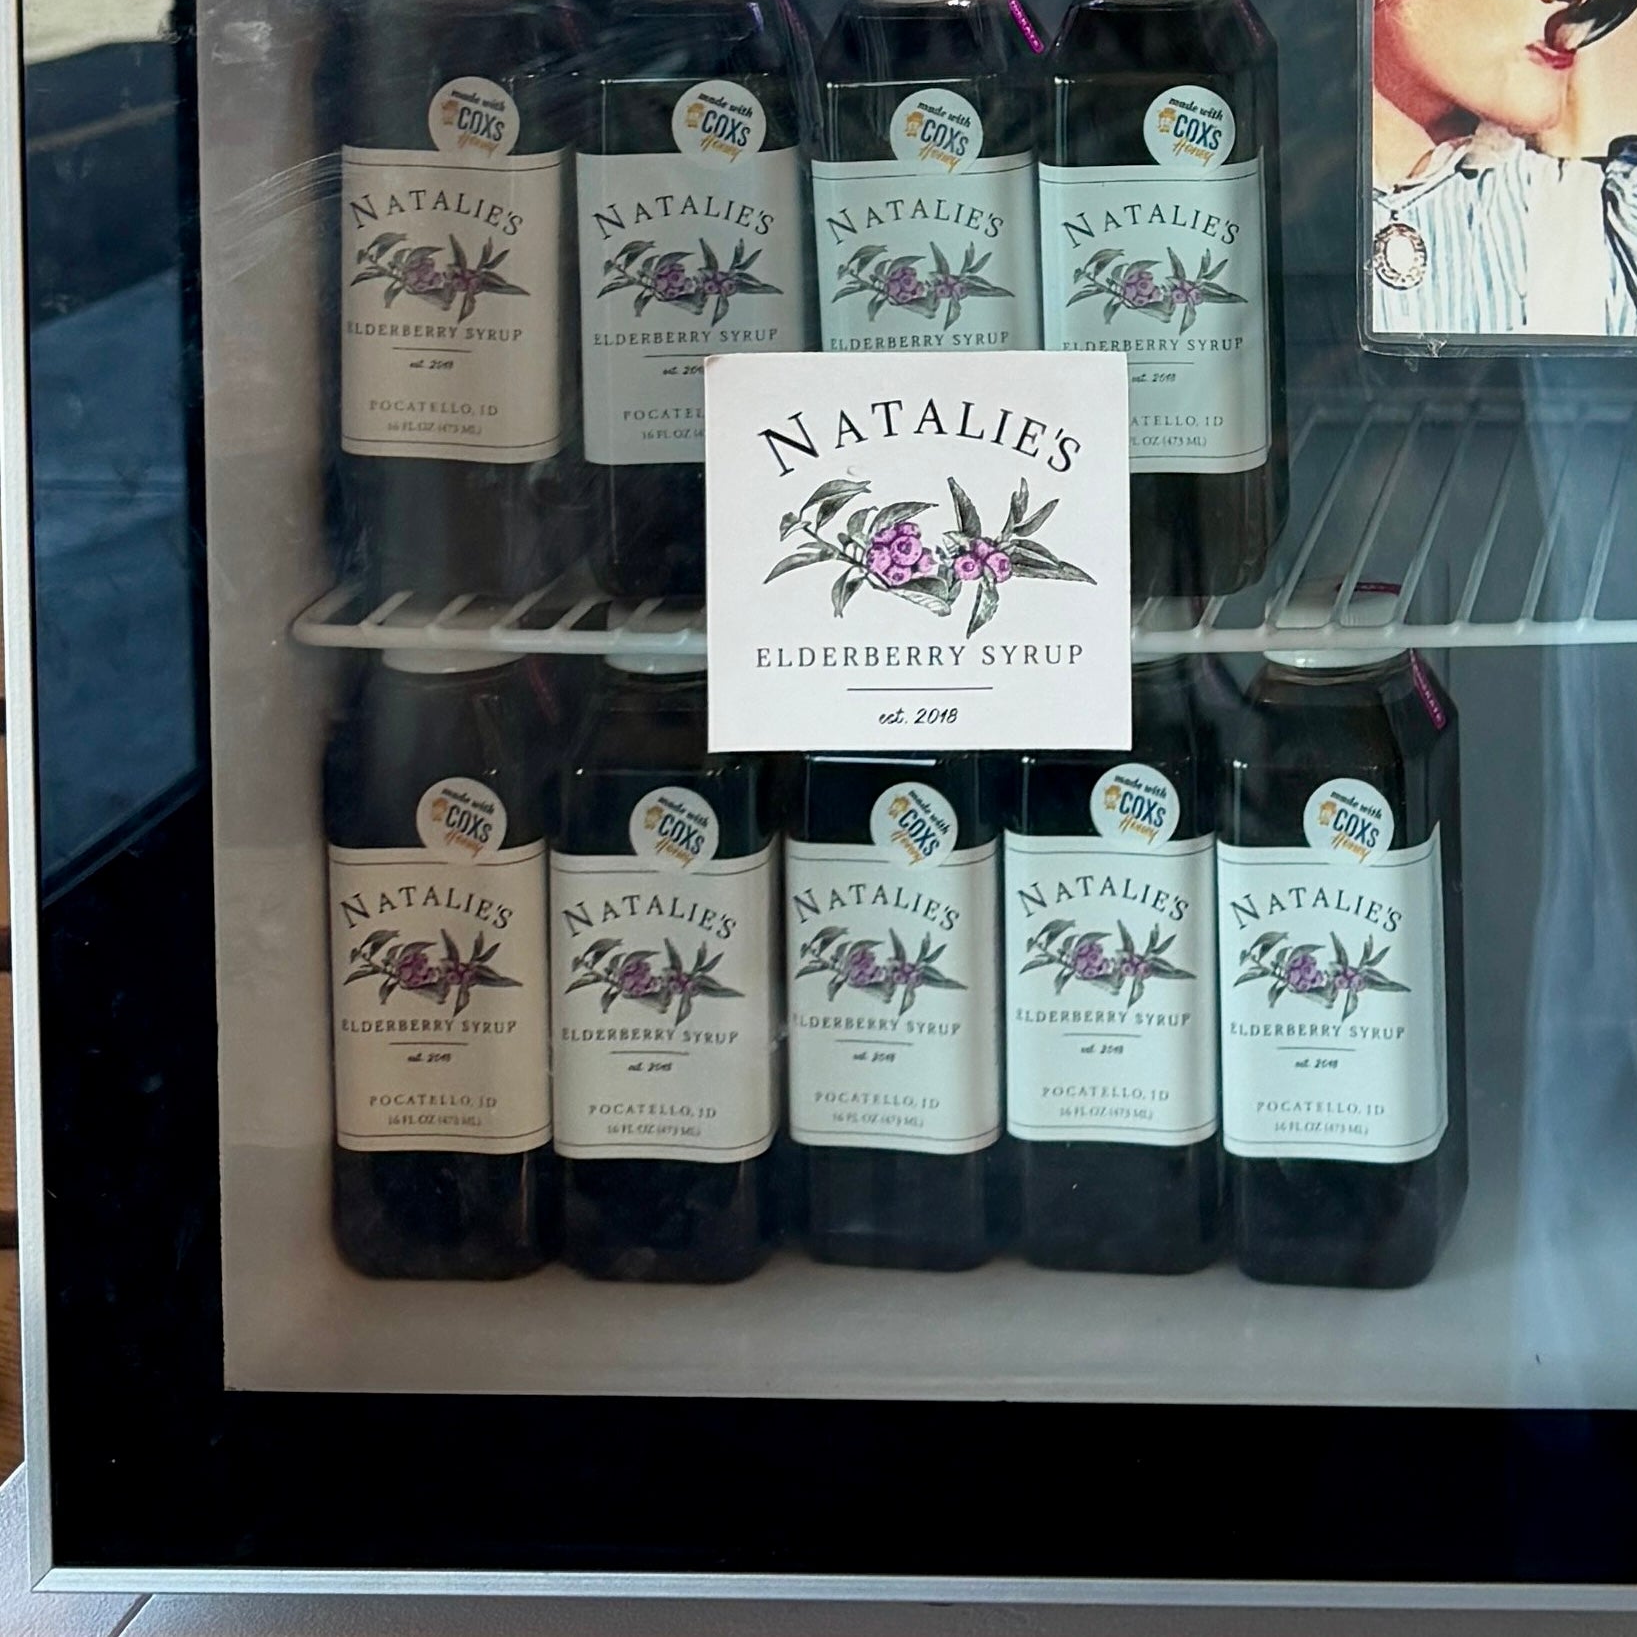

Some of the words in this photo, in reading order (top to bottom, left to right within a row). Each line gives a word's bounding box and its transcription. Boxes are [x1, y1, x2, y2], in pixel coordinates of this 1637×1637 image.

[349, 189, 524, 237] NATALIE'S
[593, 195, 775, 240] NATALIE'S
[826, 198, 1004, 245] NATALIE'S
[1062, 203, 1240, 249] NATALIE'S
[347, 320, 458, 340] ELDERBERRY
[465, 327, 523, 342] SYRUP
[593, 330, 711, 347] ELDERBERRY
[720, 328, 778, 344] SYRUP
[831, 334, 945, 352] ELDERBERRY
[953, 331, 1010, 347] SYRUP
[1187, 337, 1243, 352] SYRUP
[758, 399, 1081, 477] NATALIE'S
[757, 645, 966, 668] ELDERBERRY
[982, 644, 1084, 665] SYRUP
[879, 708, 908, 725] est.
[915, 708, 959, 724] 2018
[339, 886, 514, 930] NATALIE'S
[793, 883, 961, 932] NATALIE'S
[1018, 875, 1190, 922] NATALIE'S
[1230, 887, 1403, 933] NATALIE'S
[562, 894, 738, 940] NATALIE'S
[342, 1018, 454, 1034] ELDERBERRY
[462, 1020, 518, 1035] SYRUP
[906, 1020, 962, 1036] SYRUP
[1016, 1008, 1127, 1025] ELDERBERRY
[1135, 1012, 1191, 1027] SYRUP
[562, 1028, 675, 1044] ELDERBERRY
[684, 1030, 739, 1045] SYRUP
[1230, 1022, 1340, 1038] ELDERBERRY
[1350, 1025, 1405, 1039] SYRUP
